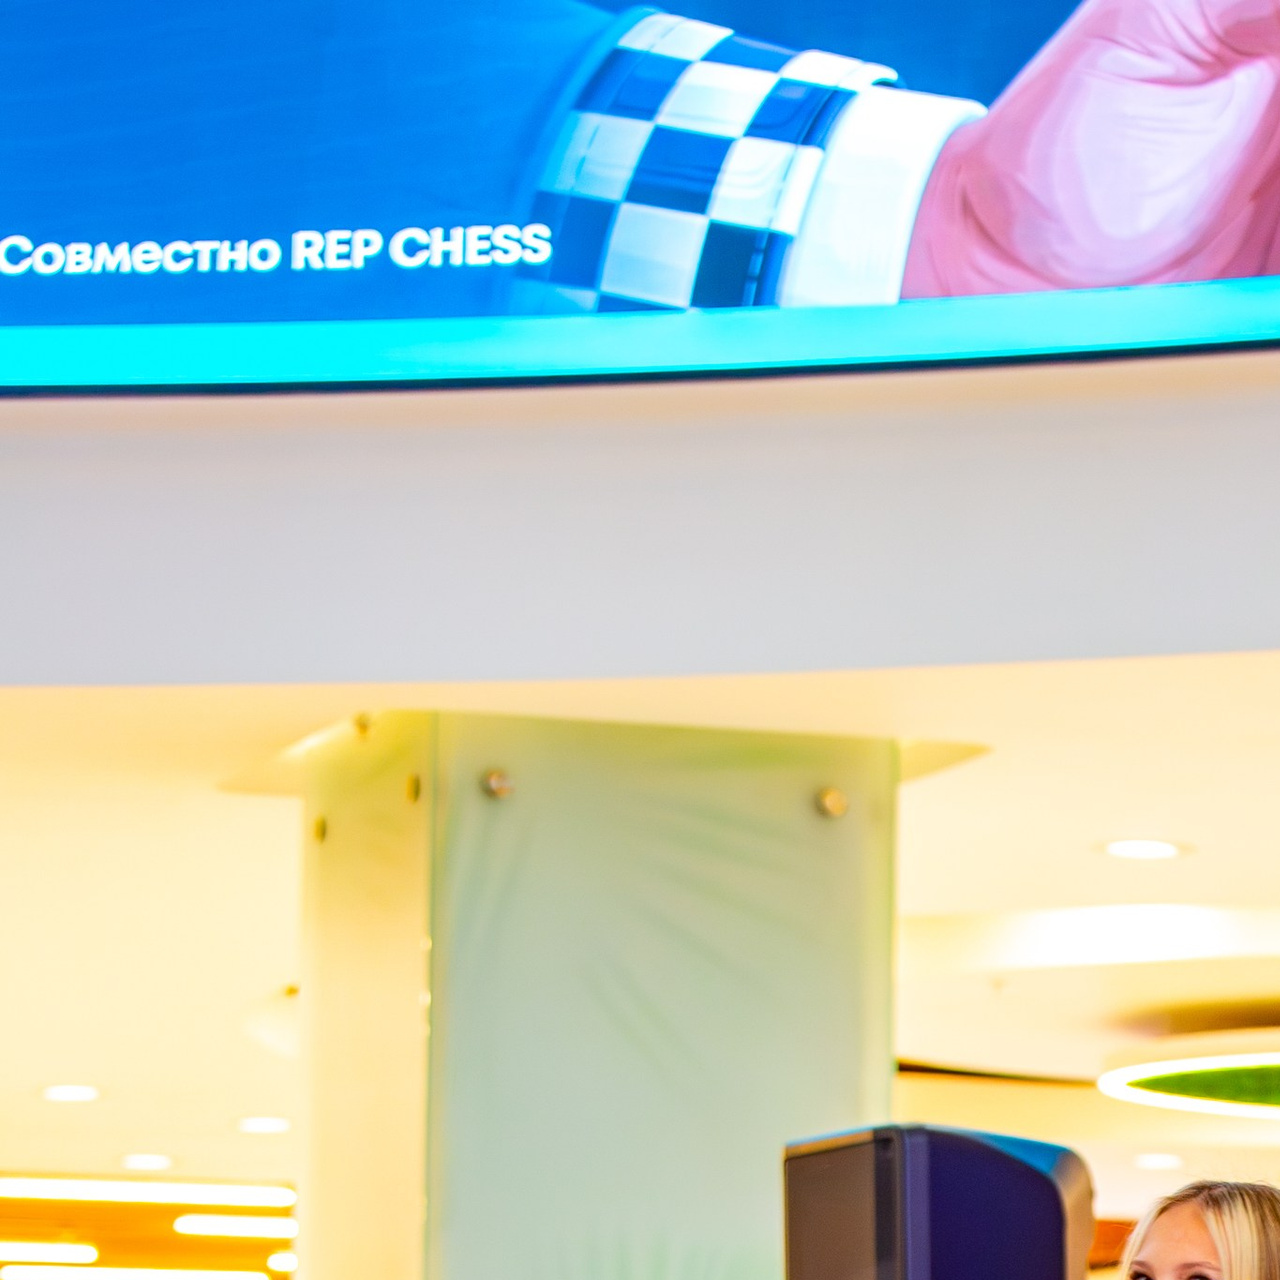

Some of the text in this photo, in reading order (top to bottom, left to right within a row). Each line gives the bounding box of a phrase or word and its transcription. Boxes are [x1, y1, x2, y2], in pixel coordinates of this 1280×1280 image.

[0, 222, 553, 276] Совместно REP CHESS
